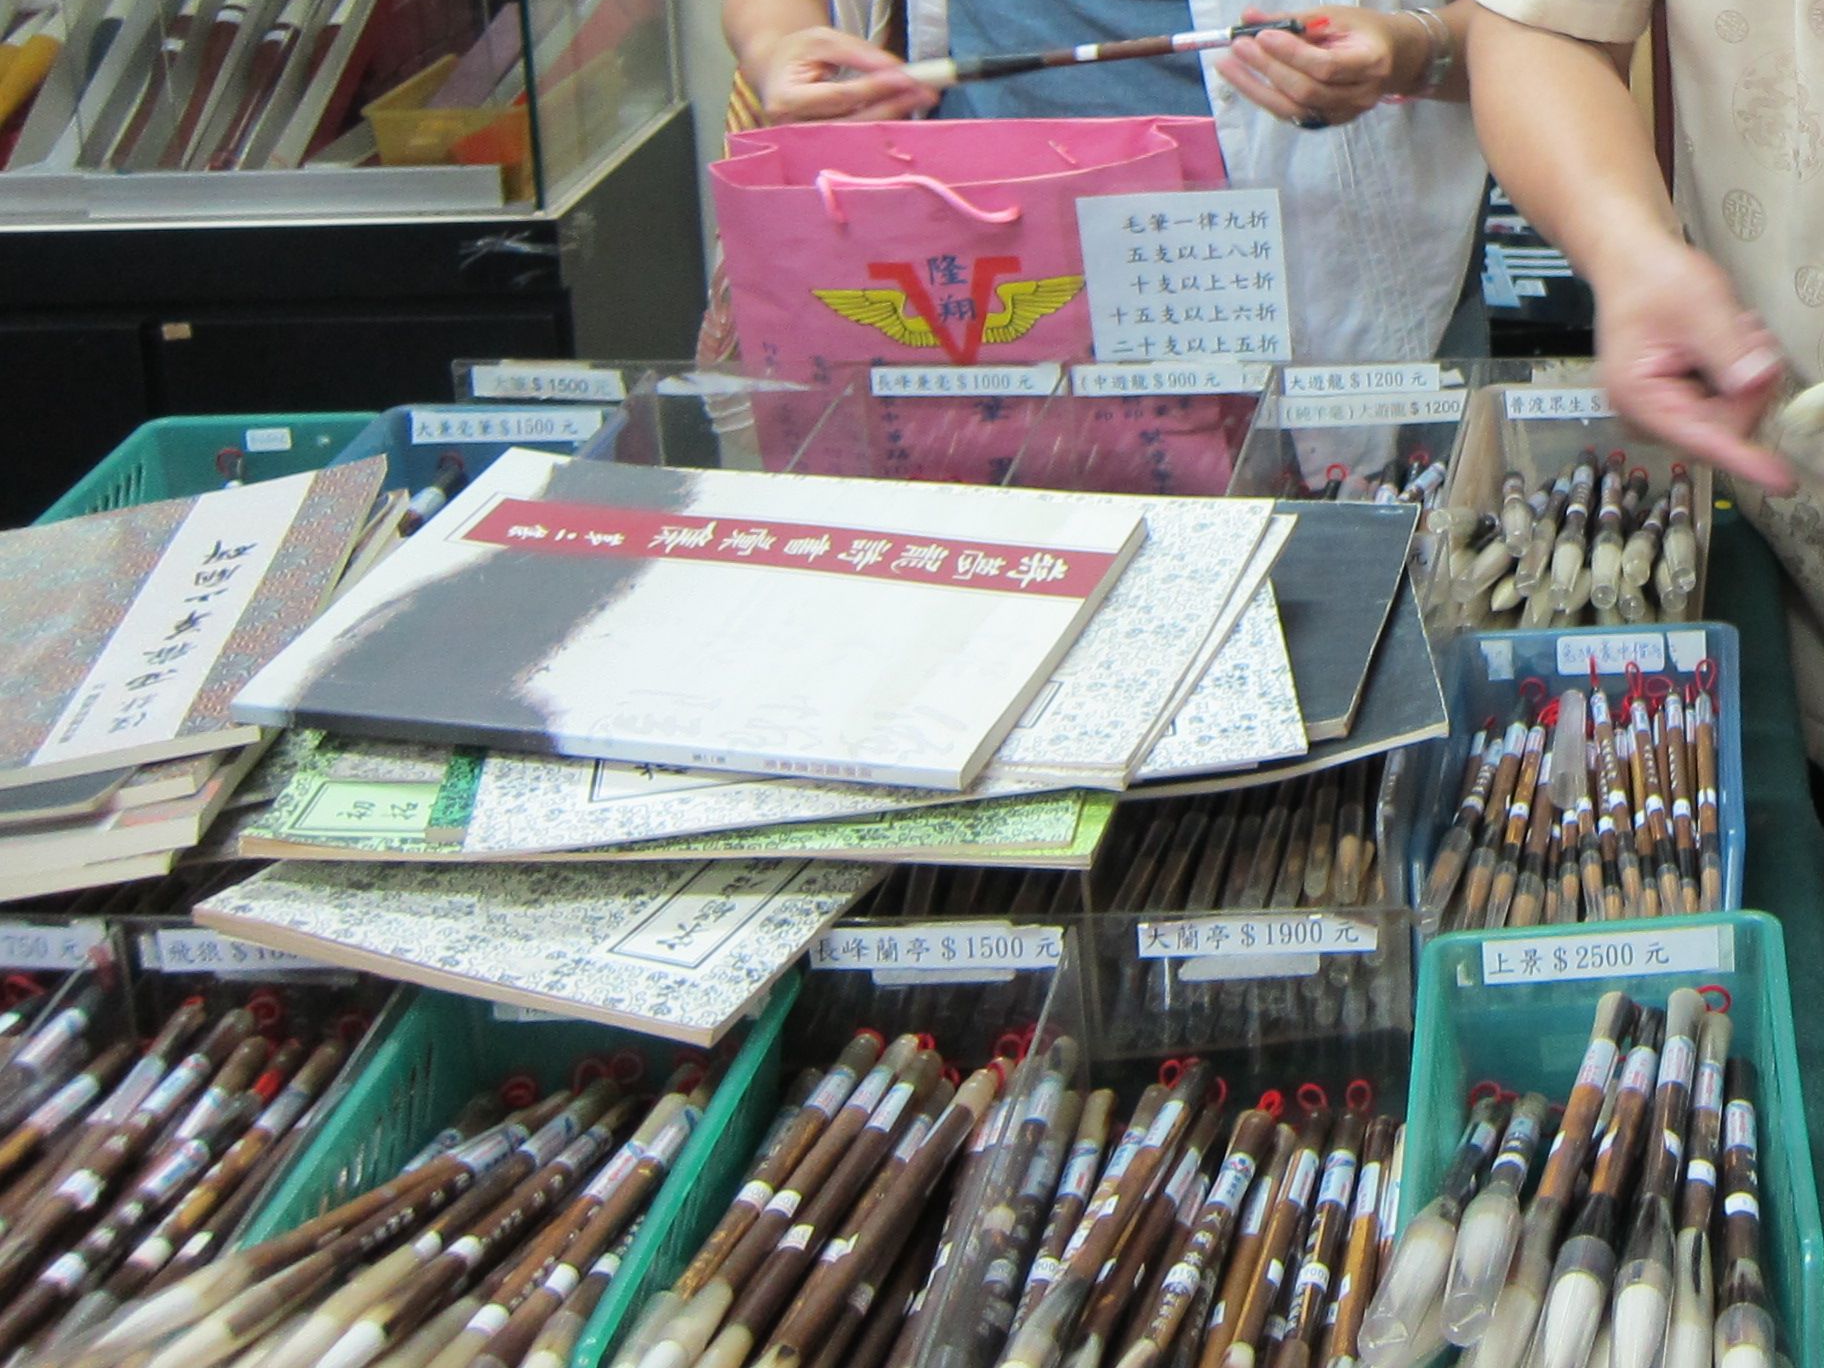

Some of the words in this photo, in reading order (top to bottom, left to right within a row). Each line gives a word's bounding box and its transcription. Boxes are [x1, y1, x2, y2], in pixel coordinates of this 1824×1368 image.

[1122, 210, 1270, 234] 毛筆一律九折
[1126, 240, 1272, 265] 五支以上八折
[1130, 271, 1275, 295] 十支以上七折
[1109, 302, 1277, 326] 十五支以上六折
[1111, 333, 1280, 357] 二十支以上五折
